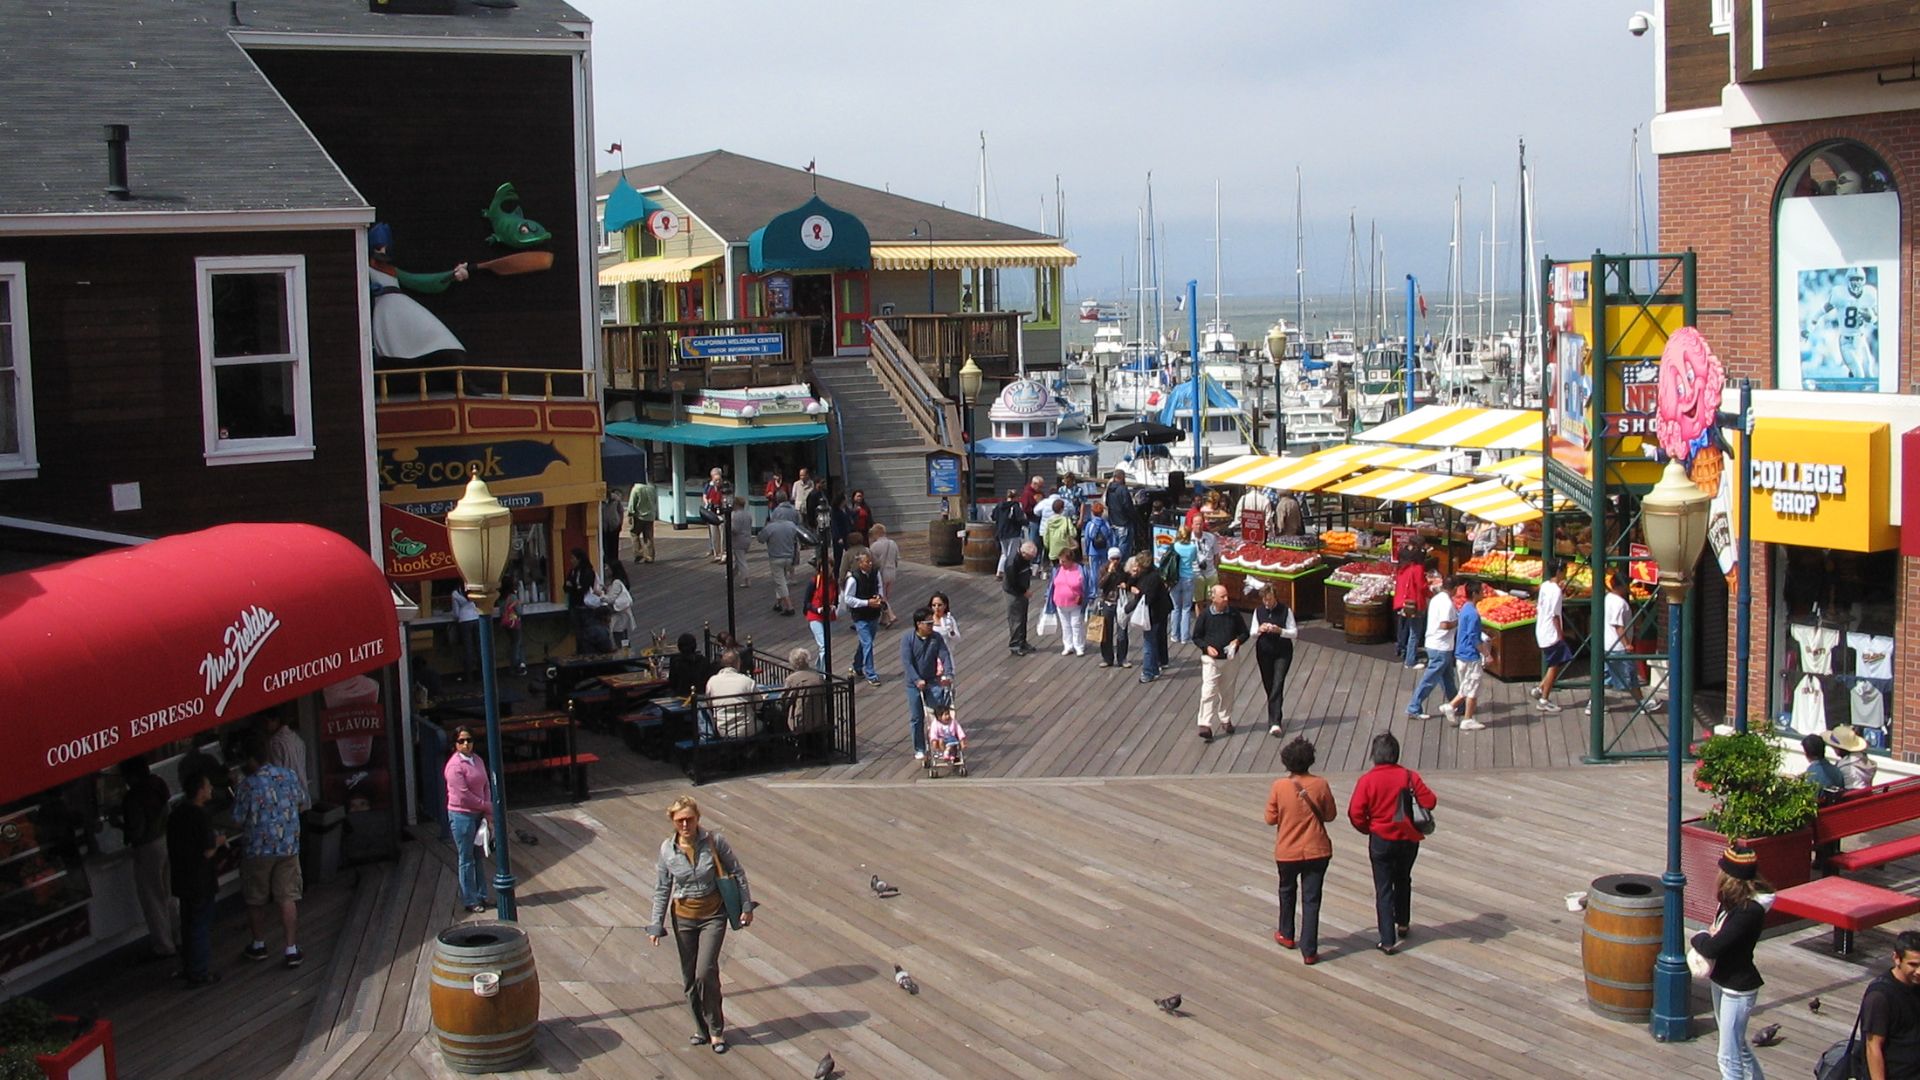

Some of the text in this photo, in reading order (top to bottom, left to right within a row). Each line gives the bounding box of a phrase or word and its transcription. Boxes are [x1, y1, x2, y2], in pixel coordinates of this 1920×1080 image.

[1844, 306, 1857, 328] 8
[1627, 384, 1657, 412] NF
[1618, 418, 1658, 433] SHO
[428, 447, 505, 482] cook
[1751, 459, 1844, 495] COLLEGE
[1772, 491, 1817, 515] SHOP
[393, 555, 431, 573] hook
[47, 638, 385, 767] COOKIES ESPRESSO CAPPUCCINO LATTE
[327, 716, 380, 734] FLAVOR
